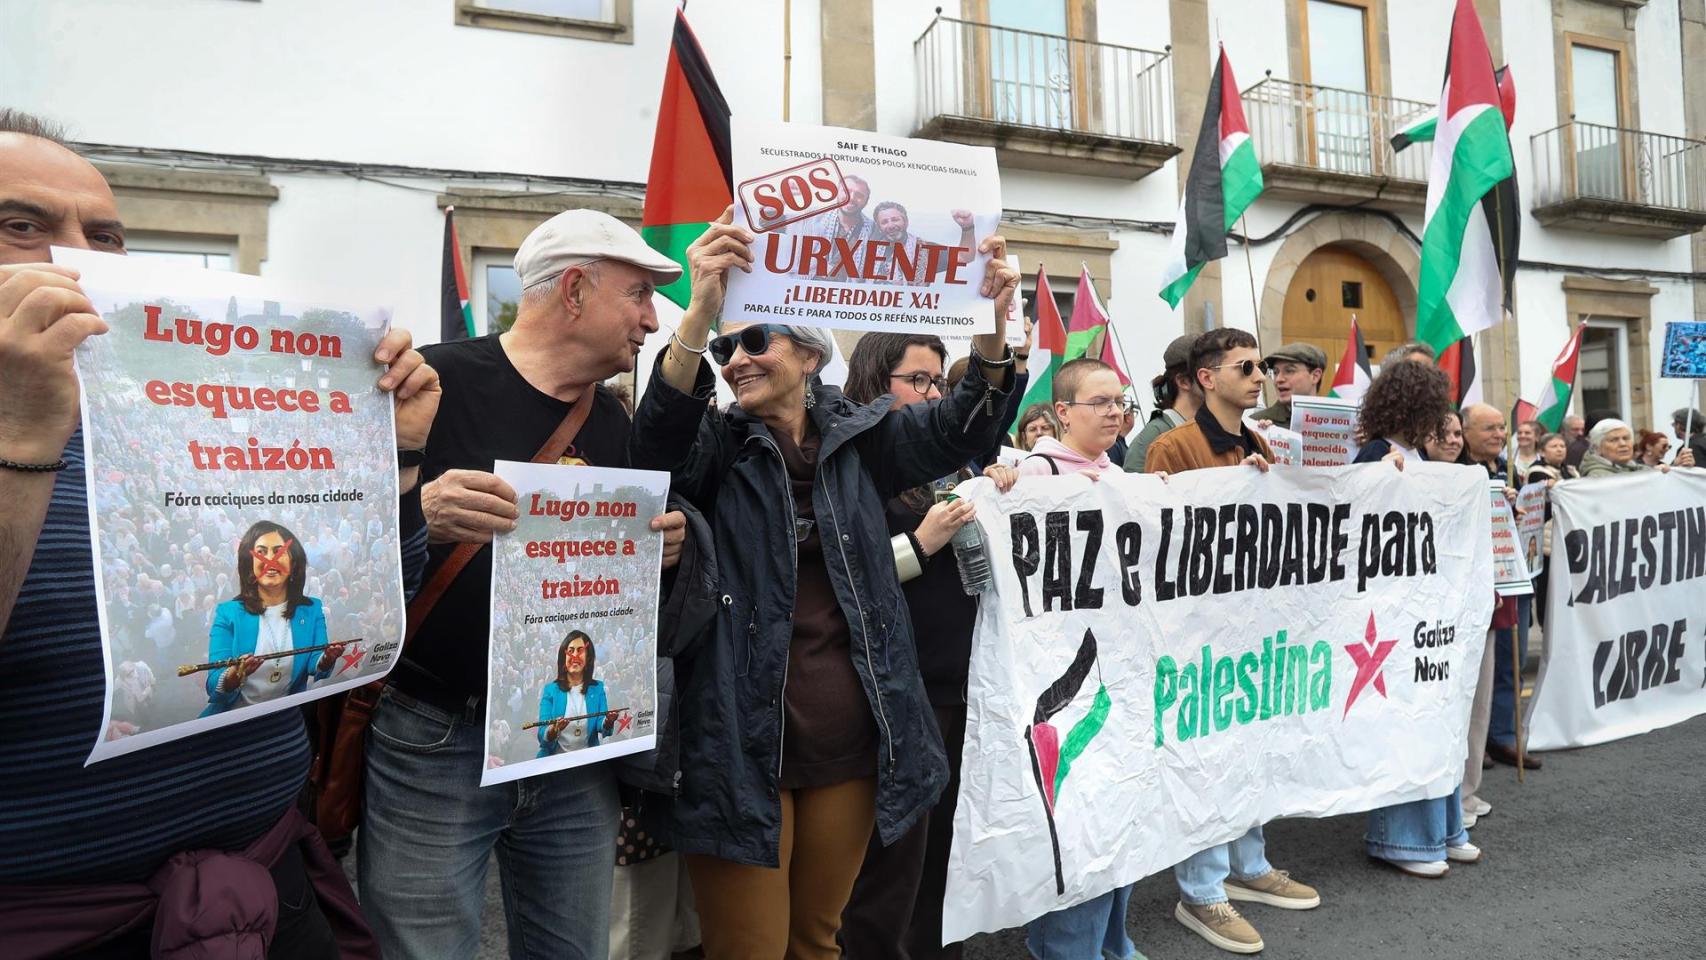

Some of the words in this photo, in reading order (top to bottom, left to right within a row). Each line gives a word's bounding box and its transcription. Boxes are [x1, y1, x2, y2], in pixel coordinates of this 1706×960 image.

[760, 147, 821, 159] SECUESTRADOS
[830, 153, 881, 165] TORTURADOS
[882, 160, 906, 168] POLOS
[907, 163, 947, 173] XENOCIDAS
[837, 141, 859, 150] SAIF
[871, 146, 908, 157] THIAGO
[753, 167, 839, 221] SOS
[764, 233, 969, 285] URXENTE
[784, 285, 904, 308] ¡LIBERDADE
[909, 292, 940, 310] XA!
[744, 303, 771, 313] PARA
[773, 306, 796, 316] ELES
[798, 307, 804, 316] E
[806, 308, 832, 318] PARA
[835, 310, 867, 321] TODOS
[869, 312, 882, 322] OS
[884, 312, 918, 323] REFÉNS
[919, 316, 975, 326] PALESTINOS
[143, 305, 259, 356] Lugo
[270, 328, 342, 358] non
[145, 379, 321, 419] esquece
[329, 390, 353, 414] a
[1305, 414, 1329, 424] Lugo
[1302, 431, 1340, 440] esquece
[187, 437, 335, 471] traizón
[164, 489, 201, 507] Fóra
[204, 492, 265, 510] caciques
[267, 491, 285, 505] da
[288, 492, 320, 504] nosa
[322, 489, 364, 503] cidade
[529, 494, 590, 521] Lugo
[594, 501, 637, 517] non
[525, 540, 617, 563] esquece
[621, 539, 636, 556] a
[1009, 509, 1105, 617] PAZ
[1115, 521, 1142, 606] e
[1154, 502, 1351, 602] LIBERDADE
[1357, 510, 1436, 593] para
[1564, 506, 1706, 607] PALESTIN
[541, 575, 620, 599] traizón
[524, 614, 543, 625] Fóra
[545, 613, 578, 624] caciques
[580, 610, 589, 620] da
[591, 610, 608, 619] nosa
[609, 607, 634, 617] cidade
[1413, 619, 1456, 649] Galiza
[370, 654, 391, 664] Nova
[374, 642, 398, 653] Galiza
[1413, 656, 1450, 683] Nova
[1592, 618, 1687, 709] LIBRE
[1154, 630, 1332, 749] Palestina
